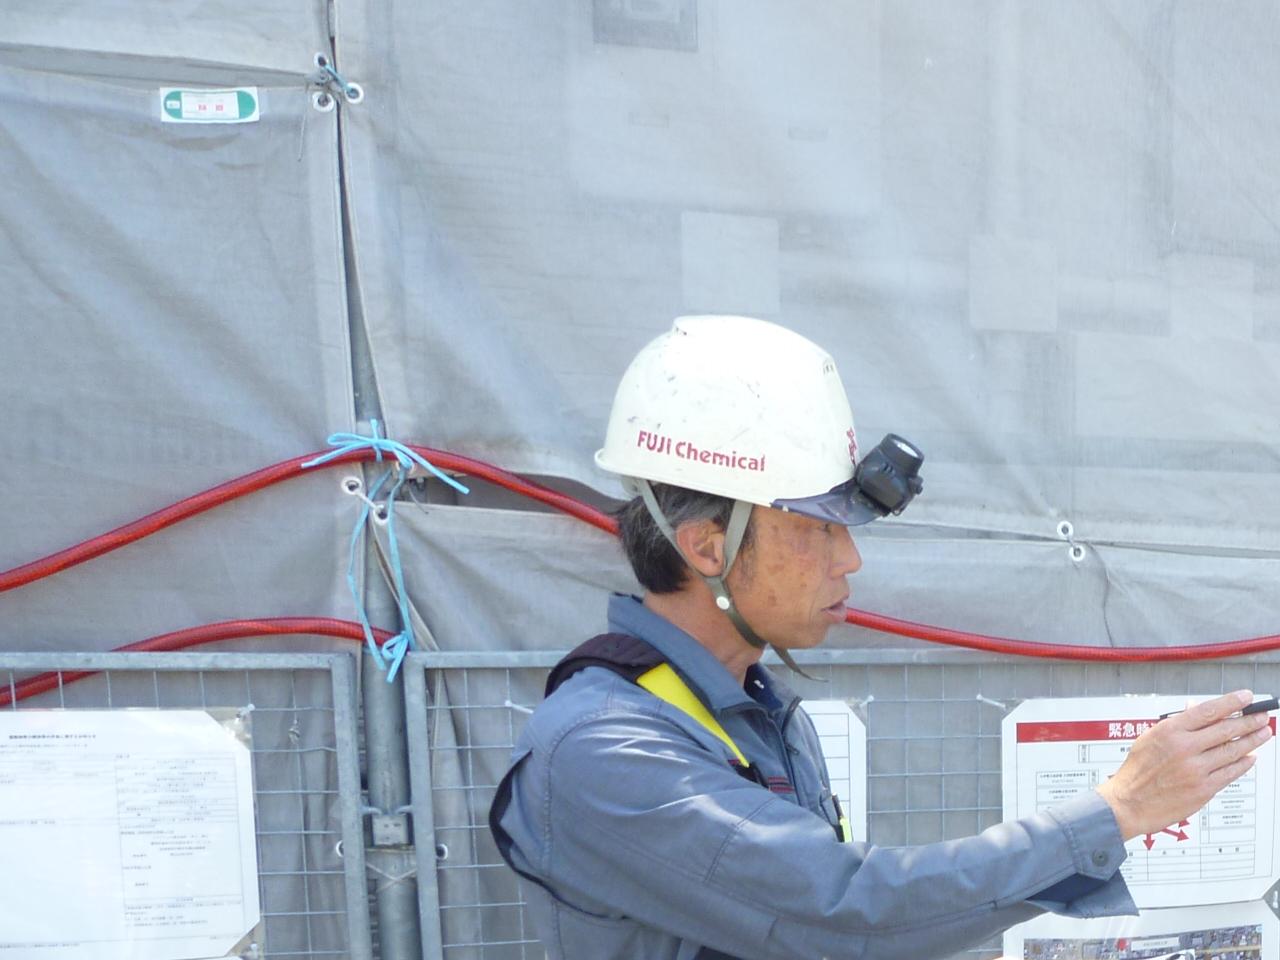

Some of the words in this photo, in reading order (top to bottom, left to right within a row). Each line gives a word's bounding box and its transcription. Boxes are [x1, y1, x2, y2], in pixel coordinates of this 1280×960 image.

[636, 430, 672, 455] FUJI
[675, 440, 766, 472] Chemical
[1108, 721, 1155, 738] 緊急時
